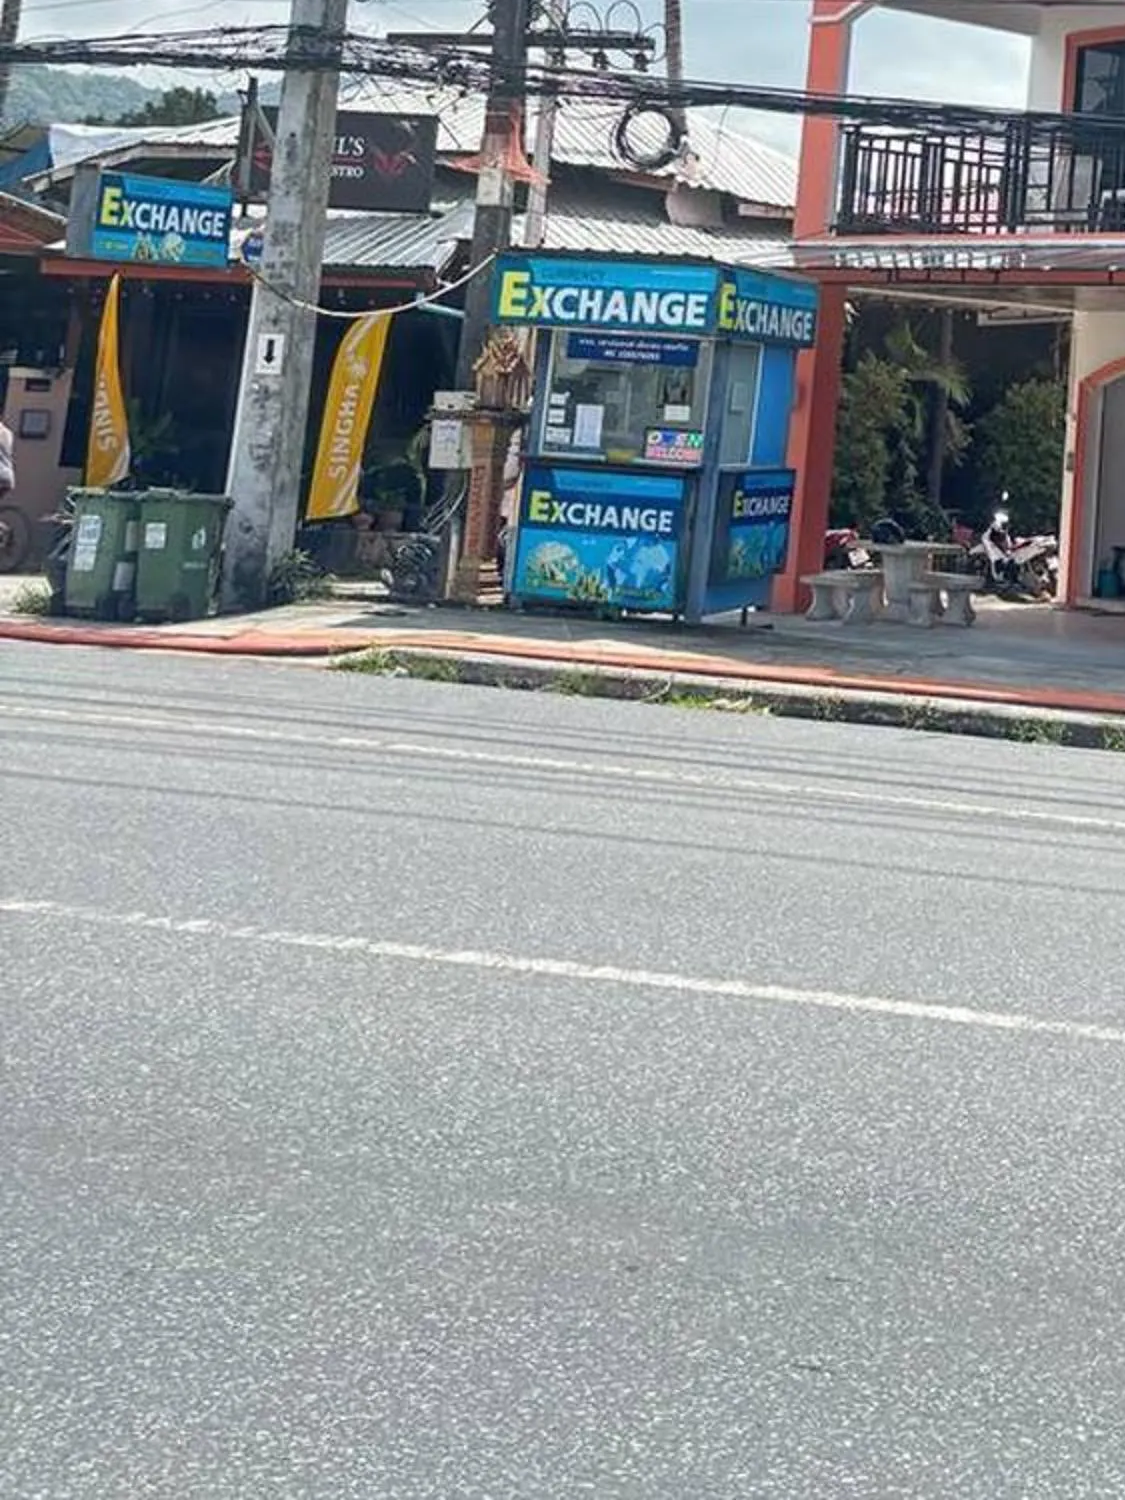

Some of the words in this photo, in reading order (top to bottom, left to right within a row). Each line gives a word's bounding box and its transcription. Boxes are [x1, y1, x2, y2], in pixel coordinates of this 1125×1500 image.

[100, 186, 225, 239] EXCHANGE
[498, 270, 709, 328] EXCHANGE
[717, 283, 813, 342] EXCHANGE
[328, 383, 363, 481] SINGHA
[528, 490, 674, 534] EXCHANGE
[732, 489, 791, 519] EXCHANGE
